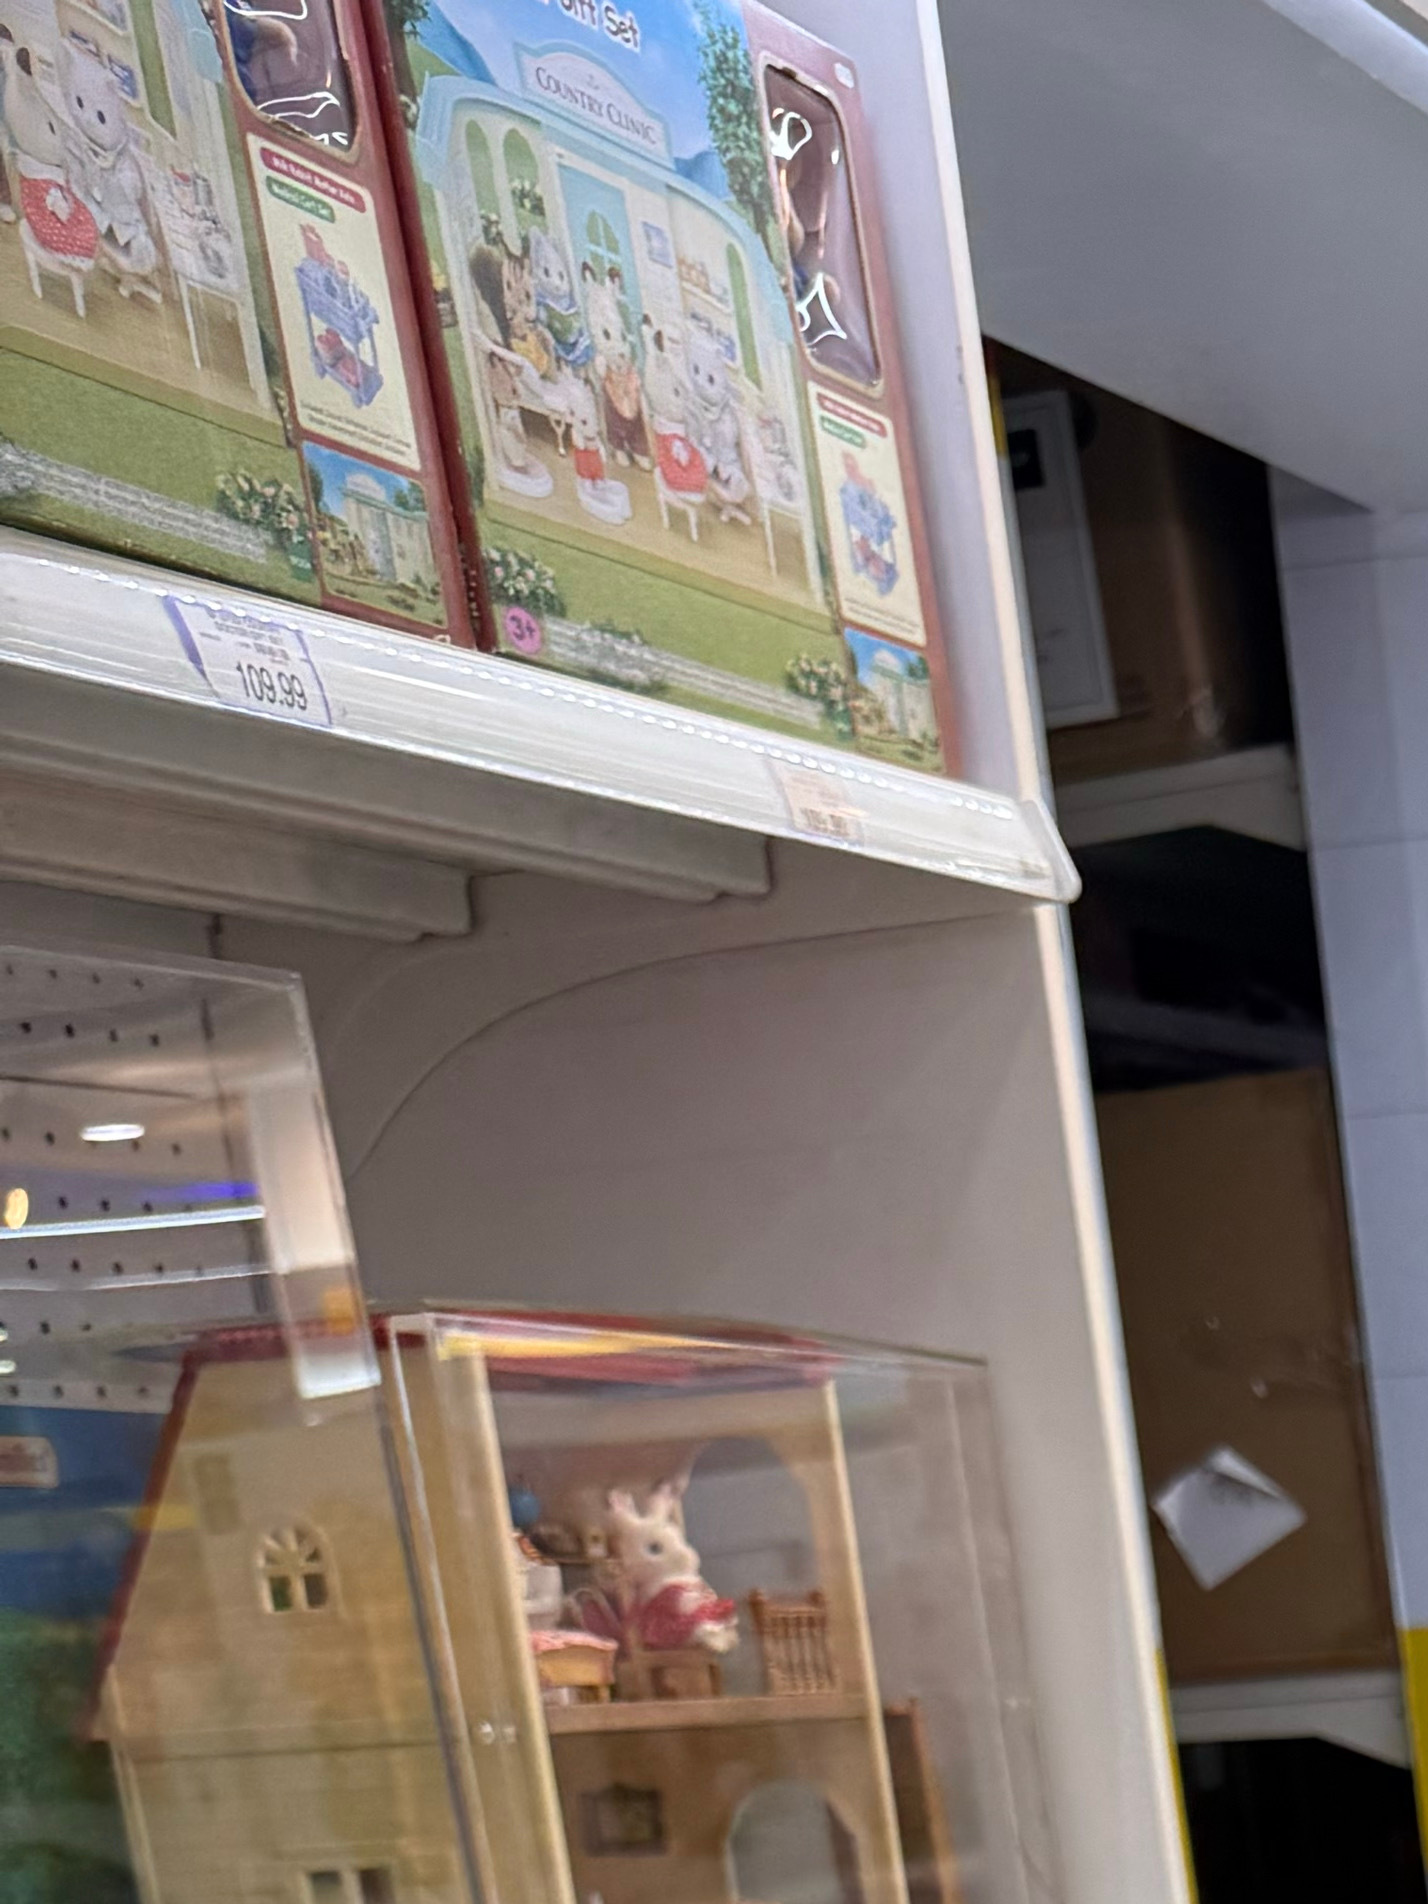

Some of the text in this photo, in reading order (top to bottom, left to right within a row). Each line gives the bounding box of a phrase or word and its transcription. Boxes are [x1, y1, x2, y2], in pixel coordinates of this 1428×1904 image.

[604, 5, 638, 48] Set
[535, 66, 658, 145] COUNTRY CLINIC
[508, 614, 536, 642] 3+
[236, 660, 308, 711] 109.99
